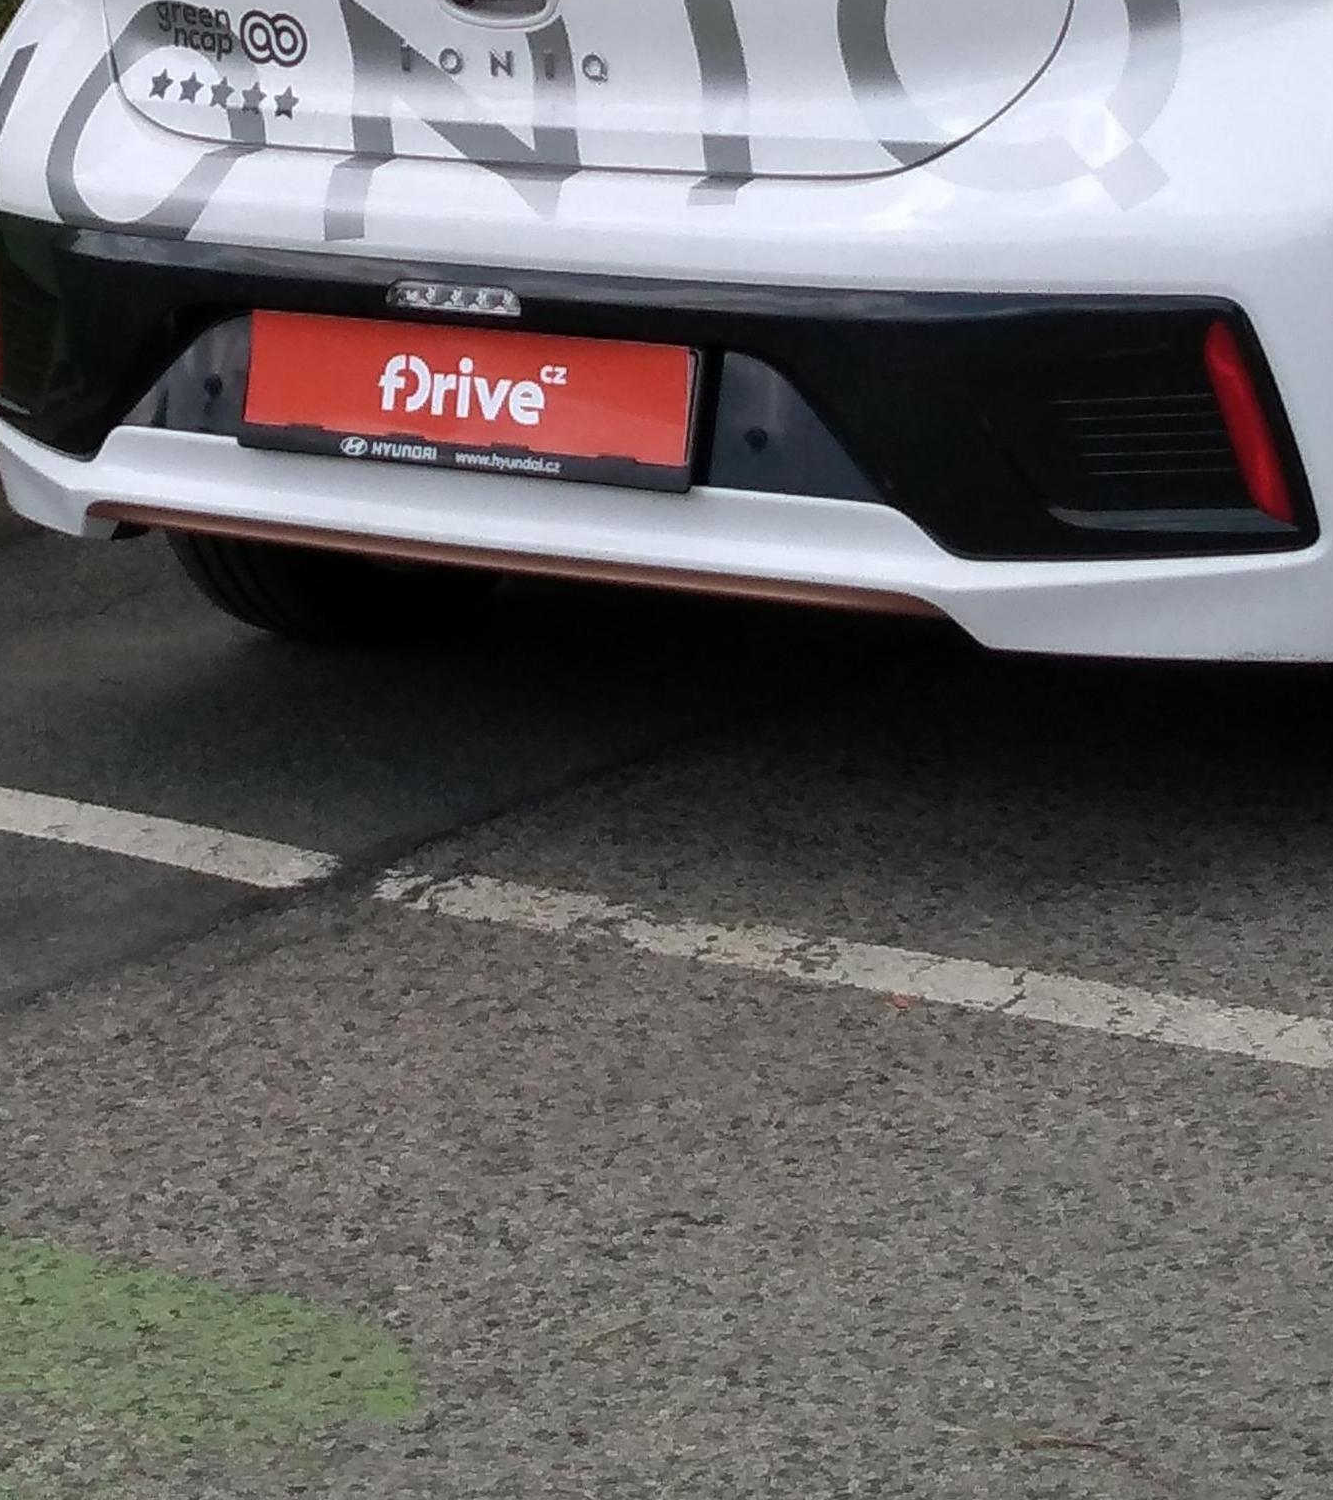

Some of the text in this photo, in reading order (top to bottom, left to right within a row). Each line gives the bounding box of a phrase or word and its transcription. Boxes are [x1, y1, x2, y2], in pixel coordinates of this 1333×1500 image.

[156, 2, 231, 35] green
[173, 27, 234, 61] ncap
[371, 440, 561, 475] HYUNDAI www.hyundai.cz
